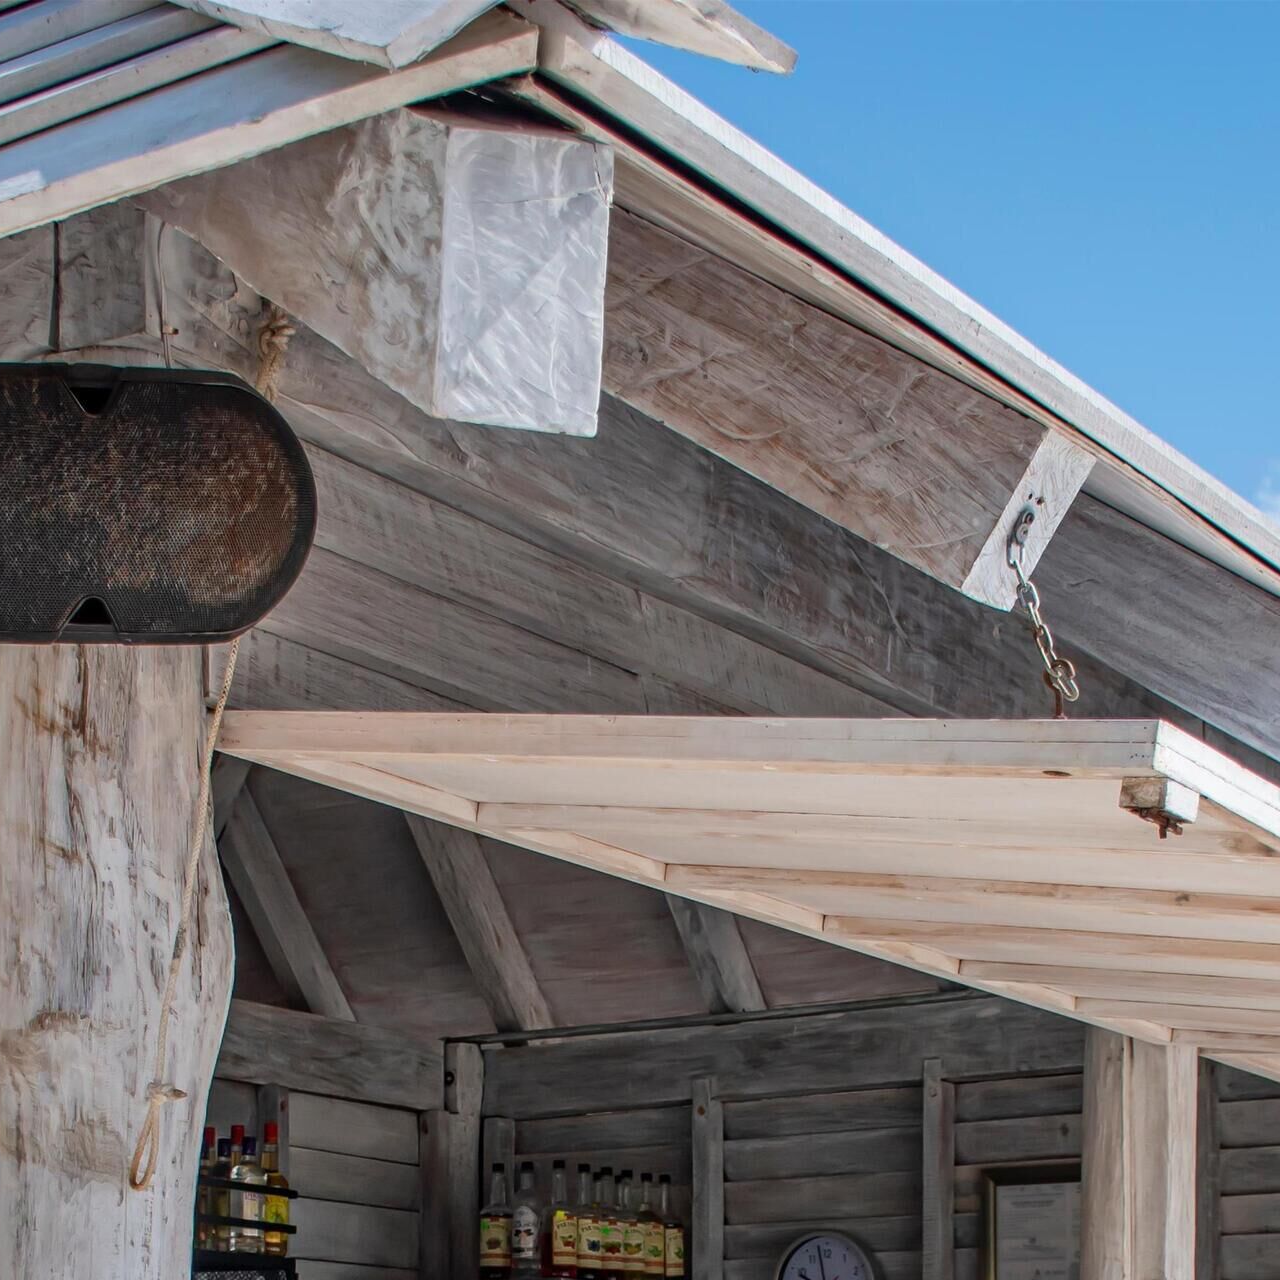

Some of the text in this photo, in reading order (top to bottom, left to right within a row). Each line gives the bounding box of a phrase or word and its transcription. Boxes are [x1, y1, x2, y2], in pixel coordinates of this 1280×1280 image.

[823, 1248, 832, 1259] 12
[842, 1253, 847, 1264] 1
[808, 1254, 817, 1265] 11
[853, 1265, 859, 1276] 2
